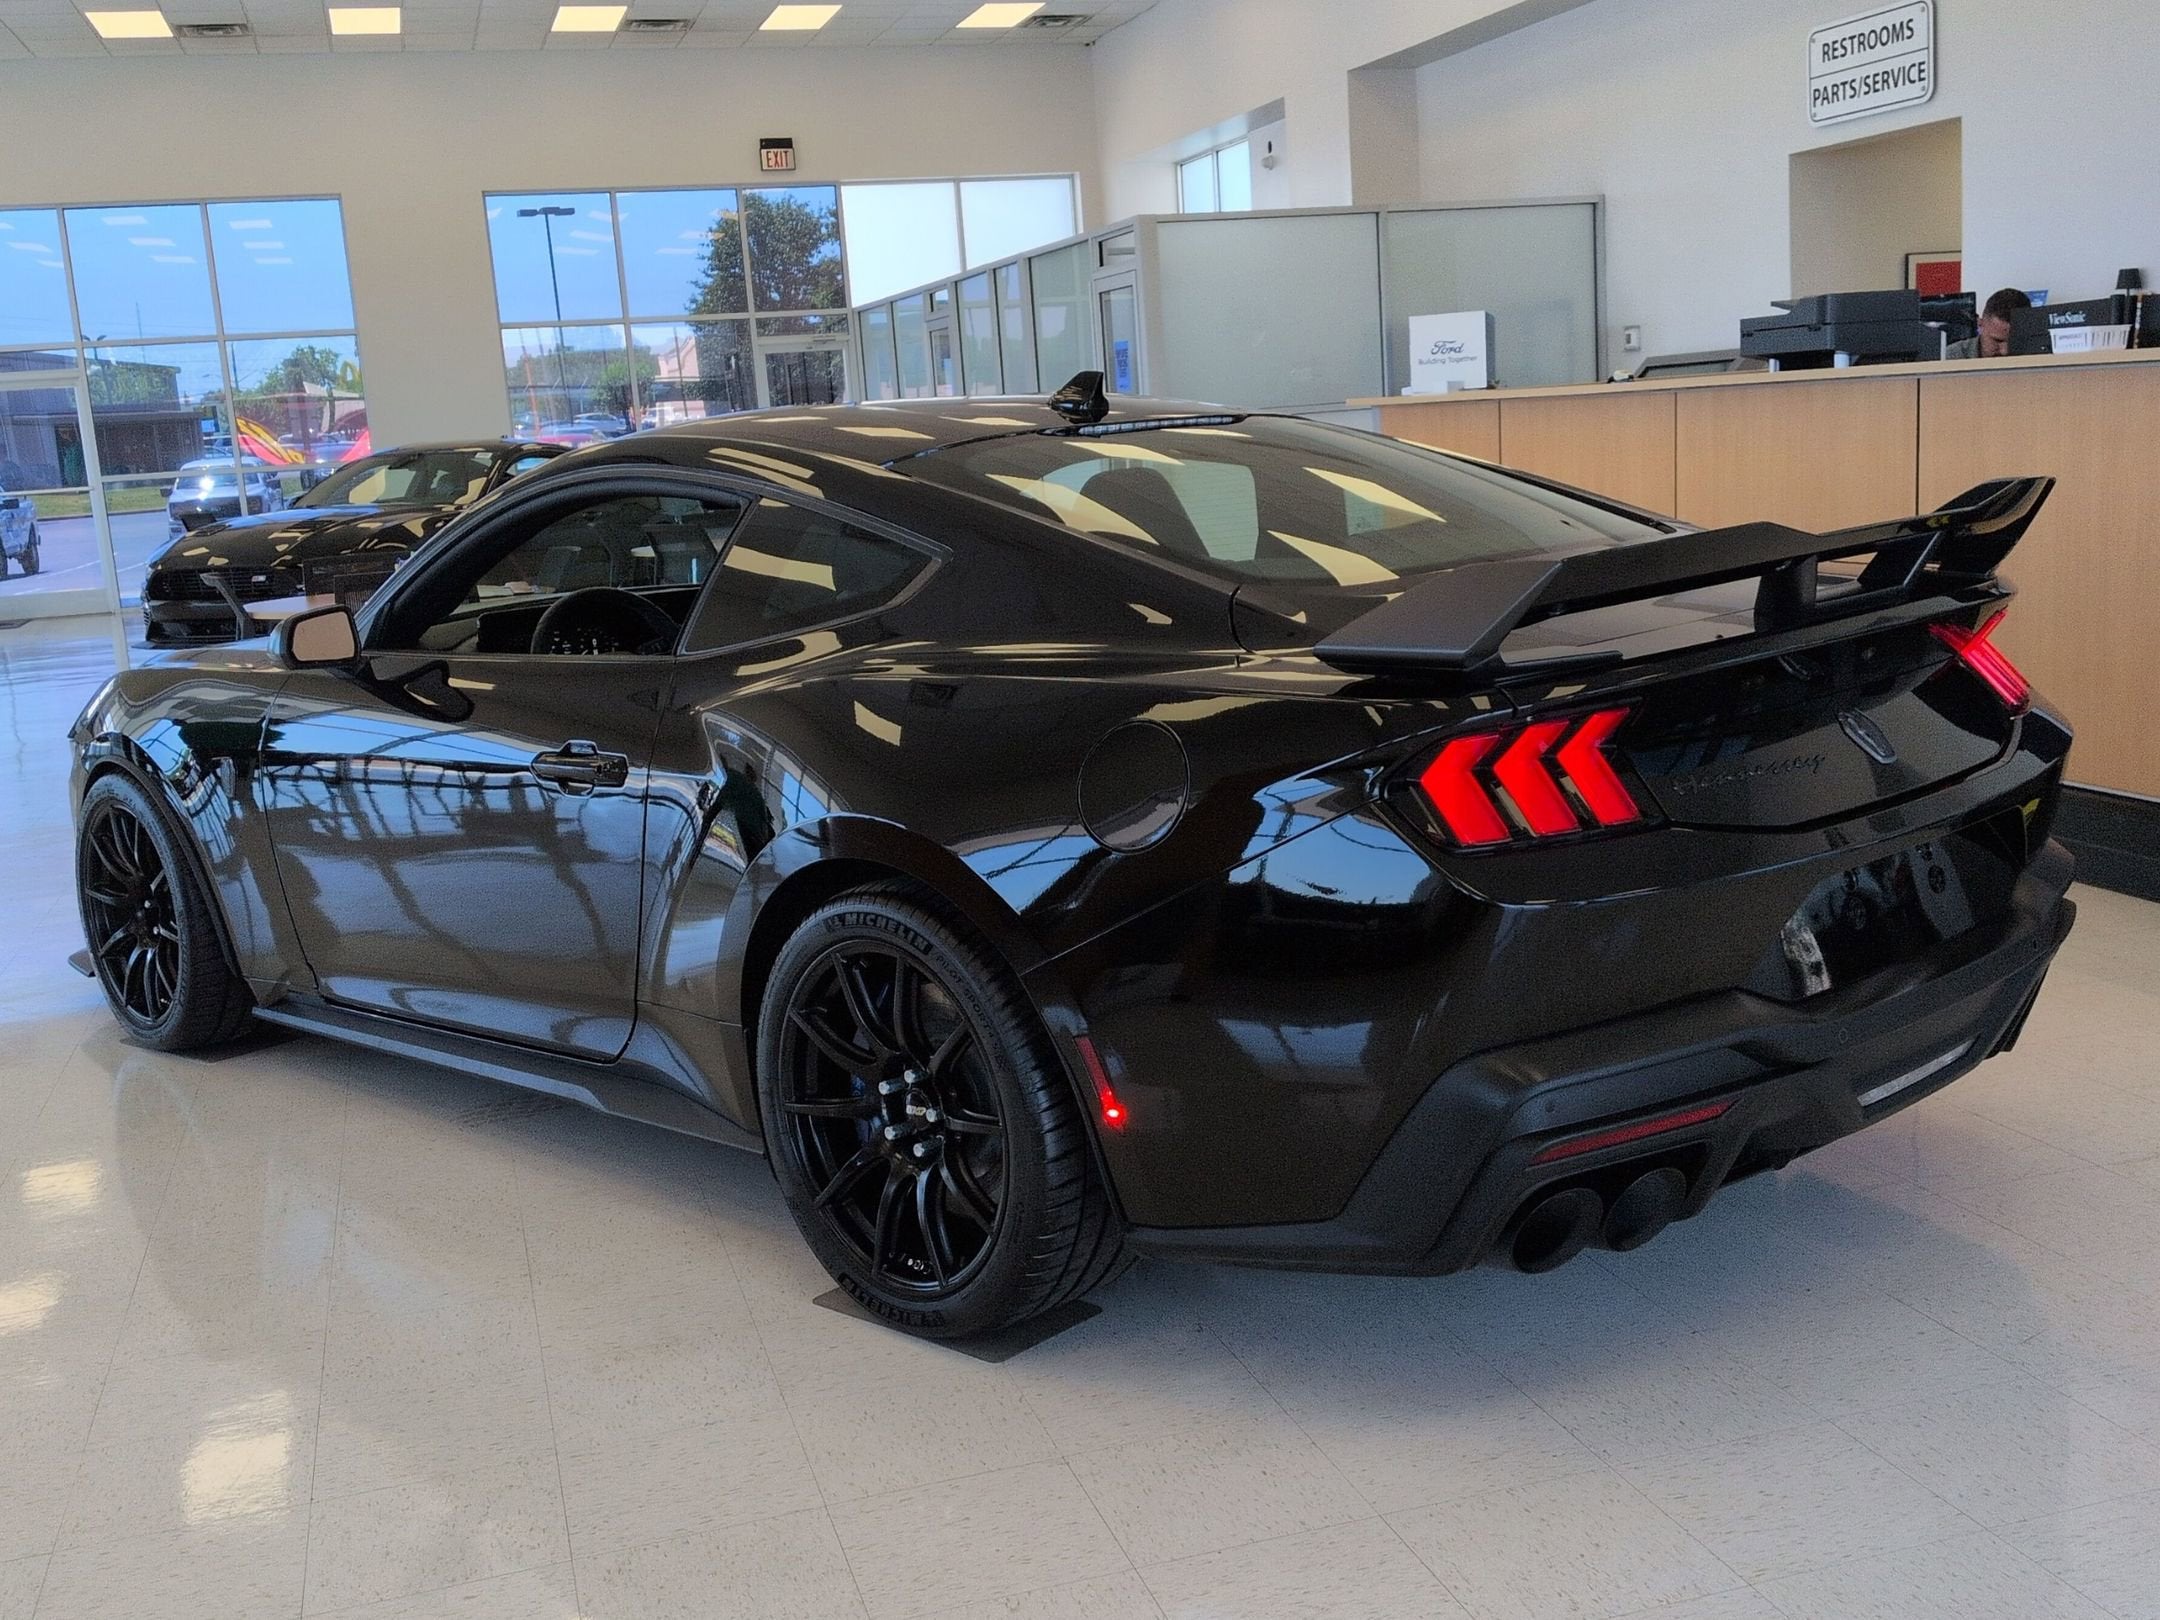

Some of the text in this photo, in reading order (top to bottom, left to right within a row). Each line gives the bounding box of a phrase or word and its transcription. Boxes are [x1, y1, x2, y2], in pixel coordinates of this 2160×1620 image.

[1822, 18, 1914, 63] RESTROOMS
[1813, 61, 1926, 108] PARTS/SERVICE
[766, 150, 789, 168] EXIT
[2049, 310, 2086, 325] ViewSonic
[1430, 340, 1465, 355] Ford
[845, 912, 929, 952] MICHELIN
[936, 955, 962, 983] PILOT
